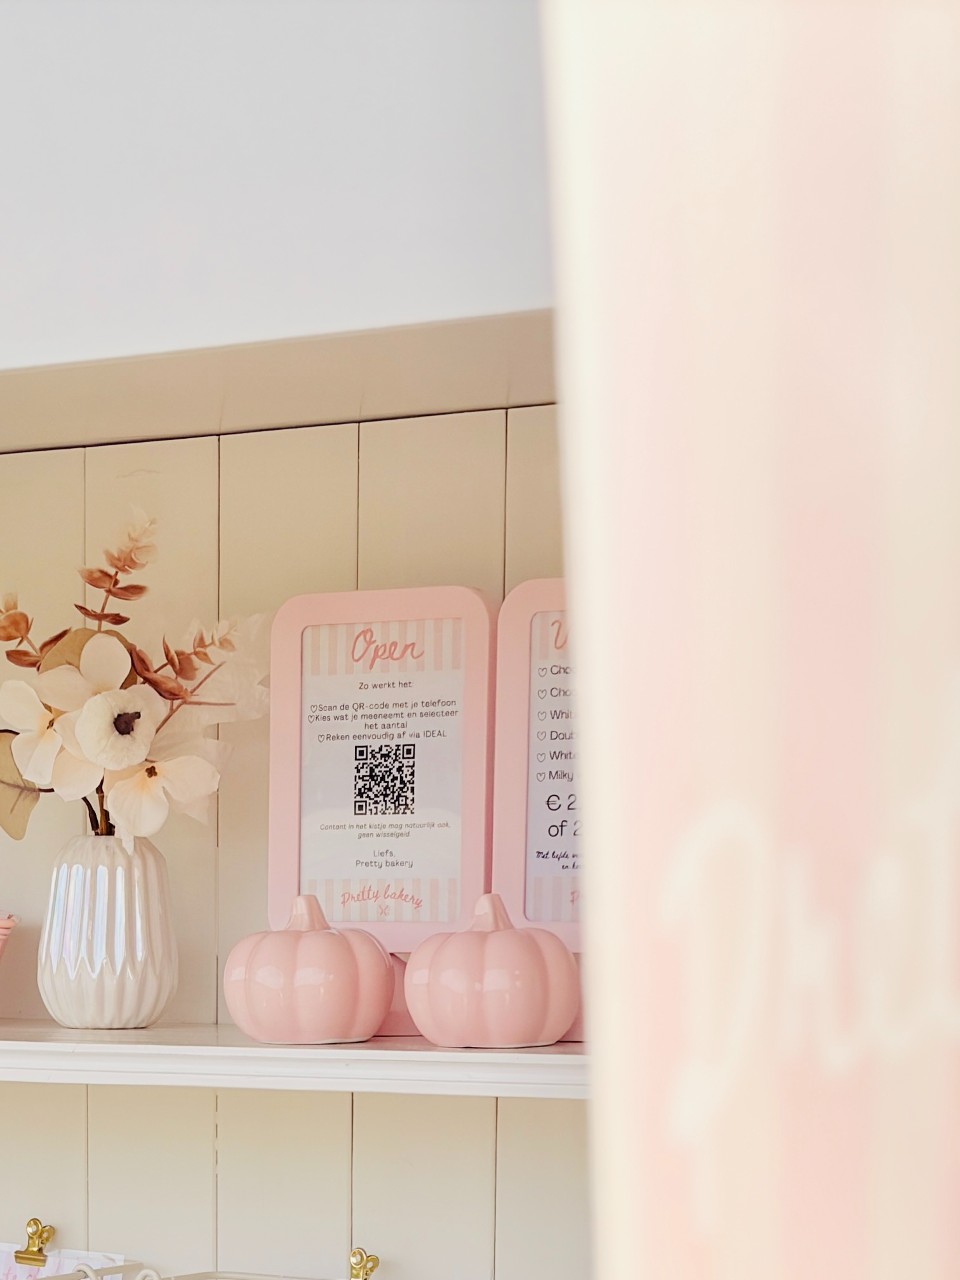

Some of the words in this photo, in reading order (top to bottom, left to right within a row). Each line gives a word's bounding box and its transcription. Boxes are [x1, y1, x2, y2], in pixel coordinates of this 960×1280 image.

[351, 628, 424, 670] Open
[550, 665, 574, 675] Cho
[358, 682, 369, 690] Zo
[372, 681, 396, 689] werkt
[550, 687, 574, 698] Cho
[318, 703, 338, 711] Scan
[352, 702, 389, 712] QR-code
[411, 702, 418, 710] je
[421, 699, 457, 708] telefoon
[334, 713, 349, 721] wat
[350, 713, 358, 722] je
[361, 712, 405, 720] meeneemt
[420, 710, 459, 718] selecteer
[550, 709, 573, 719] Whit
[364, 722, 378, 730] het
[381, 721, 408, 729] aantal
[326, 733, 350, 741] Reken
[352, 731, 394, 741] eenvoudig
[397, 730, 406, 739] af
[409, 731, 421, 739] via
[549, 770, 574, 782] Milky
[546, 794, 561, 811] €
[548, 820, 567, 837] of
[356, 859, 383, 869] Pretty
[385, 859, 413, 869] bakery
[341, 884, 380, 908] Pretty
[383, 883, 423, 910] bakery
